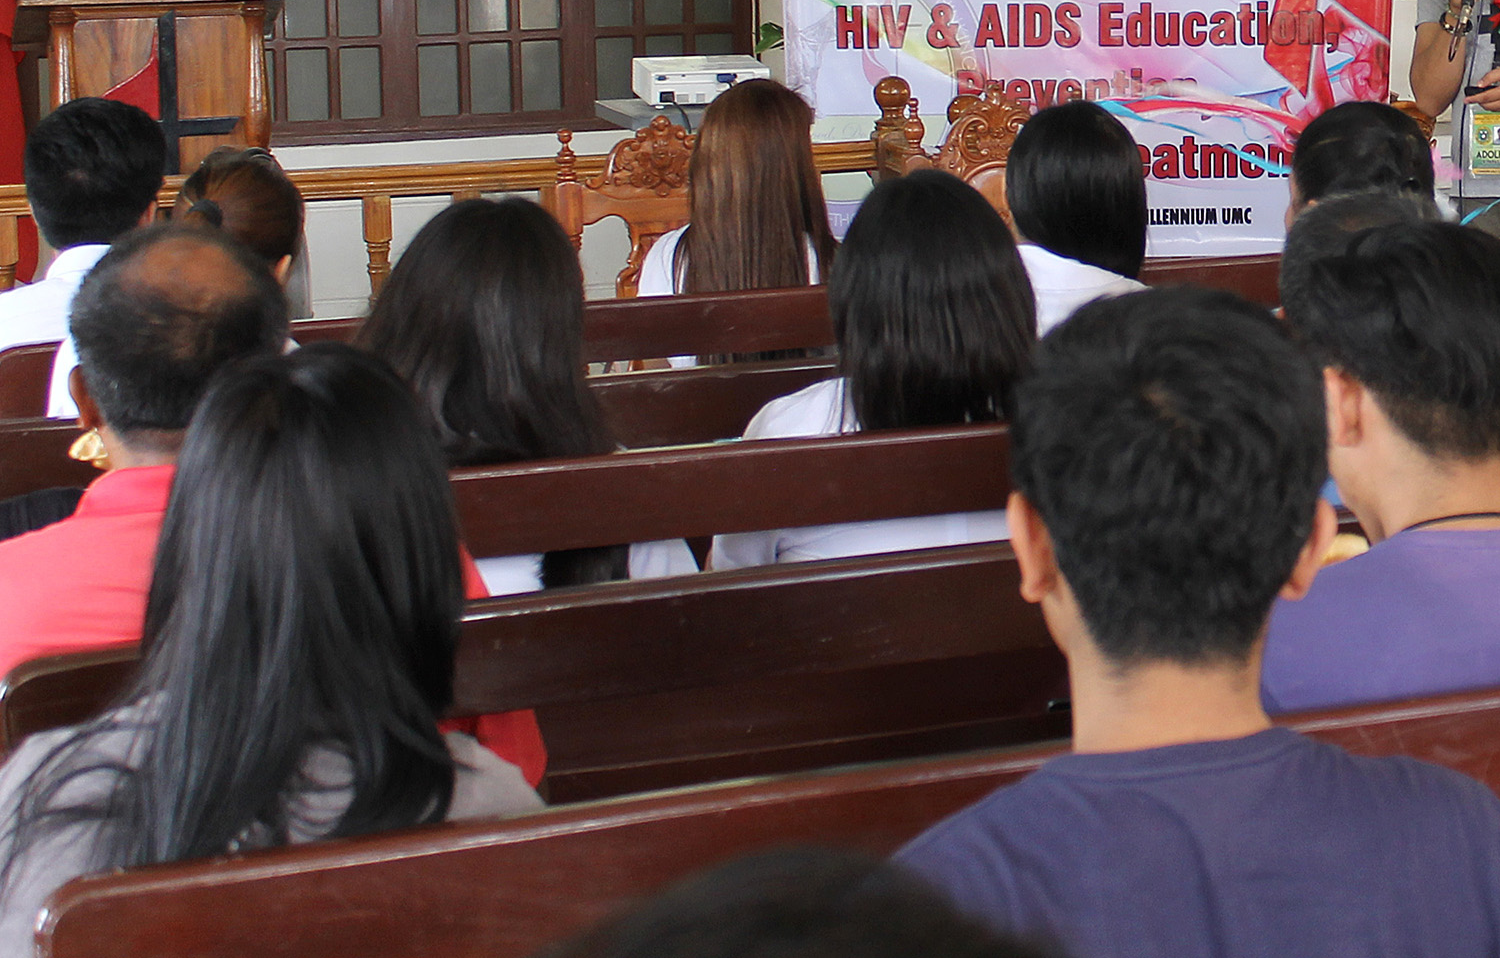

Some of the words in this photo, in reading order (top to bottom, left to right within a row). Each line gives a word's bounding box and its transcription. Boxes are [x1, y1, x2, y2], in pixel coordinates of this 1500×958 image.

[836, 4, 912, 50] HIV
[926, 3, 961, 50] &
[974, 2, 1082, 49] AIDS
[1098, 1, 1339, 53] Education,
[1136, 135, 1293, 179] eatmen
[1146, 208, 1218, 225] ILLENNIUM
[1221, 207, 1252, 225] UMC
